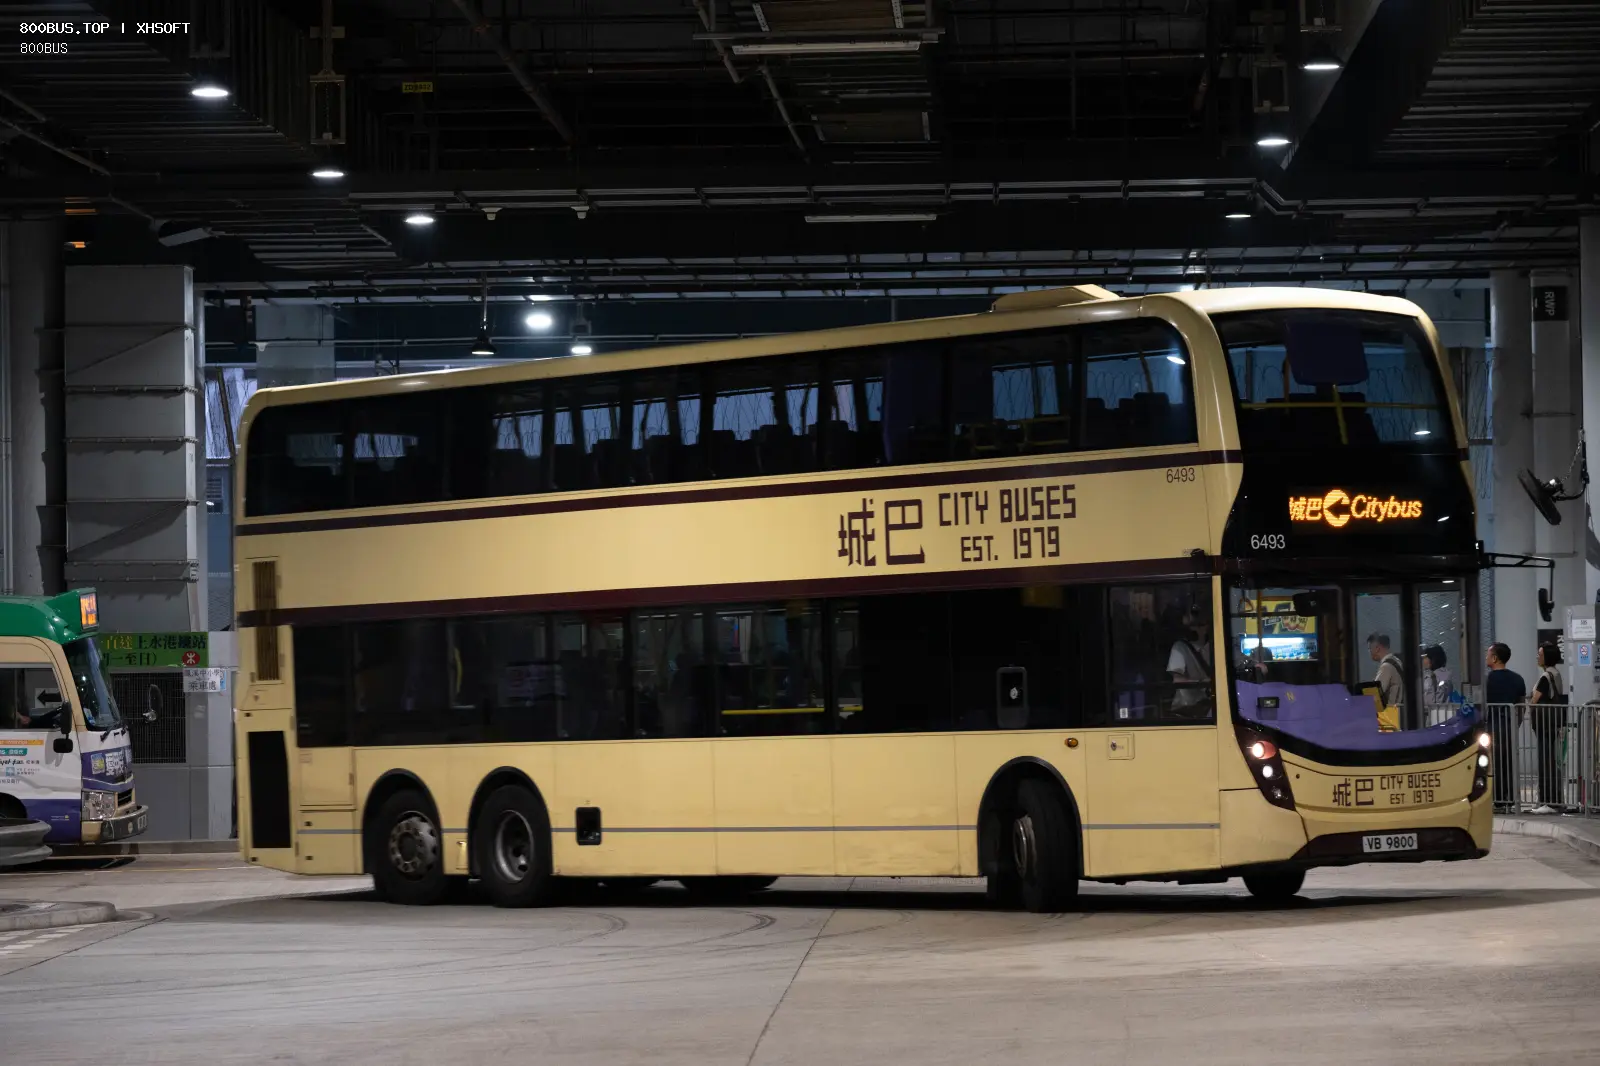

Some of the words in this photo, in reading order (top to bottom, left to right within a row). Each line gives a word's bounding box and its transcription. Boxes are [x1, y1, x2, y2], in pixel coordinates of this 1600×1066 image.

[1544, 291, 1555, 316] RWP
[1166, 467, 1195, 484] 6493
[938, 490, 989, 527] CITY
[1000, 484, 1076, 524] BUSES
[1289, 496, 1322, 521] 城巴
[1350, 494, 1423, 523] Citybus
[838, 498, 925, 567] 城巴
[960, 535, 999, 562] EST.
[1013, 526, 1060, 560] 1979
[1250, 534, 1286, 550] 6493
[1332, 777, 1375, 807] 城巴
[1380, 775, 1404, 790] CITY
[1407, 773, 1441, 789] BUSES
[1413, 789, 1434, 804] 1979
[1366, 837, 1382, 850] VB
[1386, 835, 1414, 850] 9800
